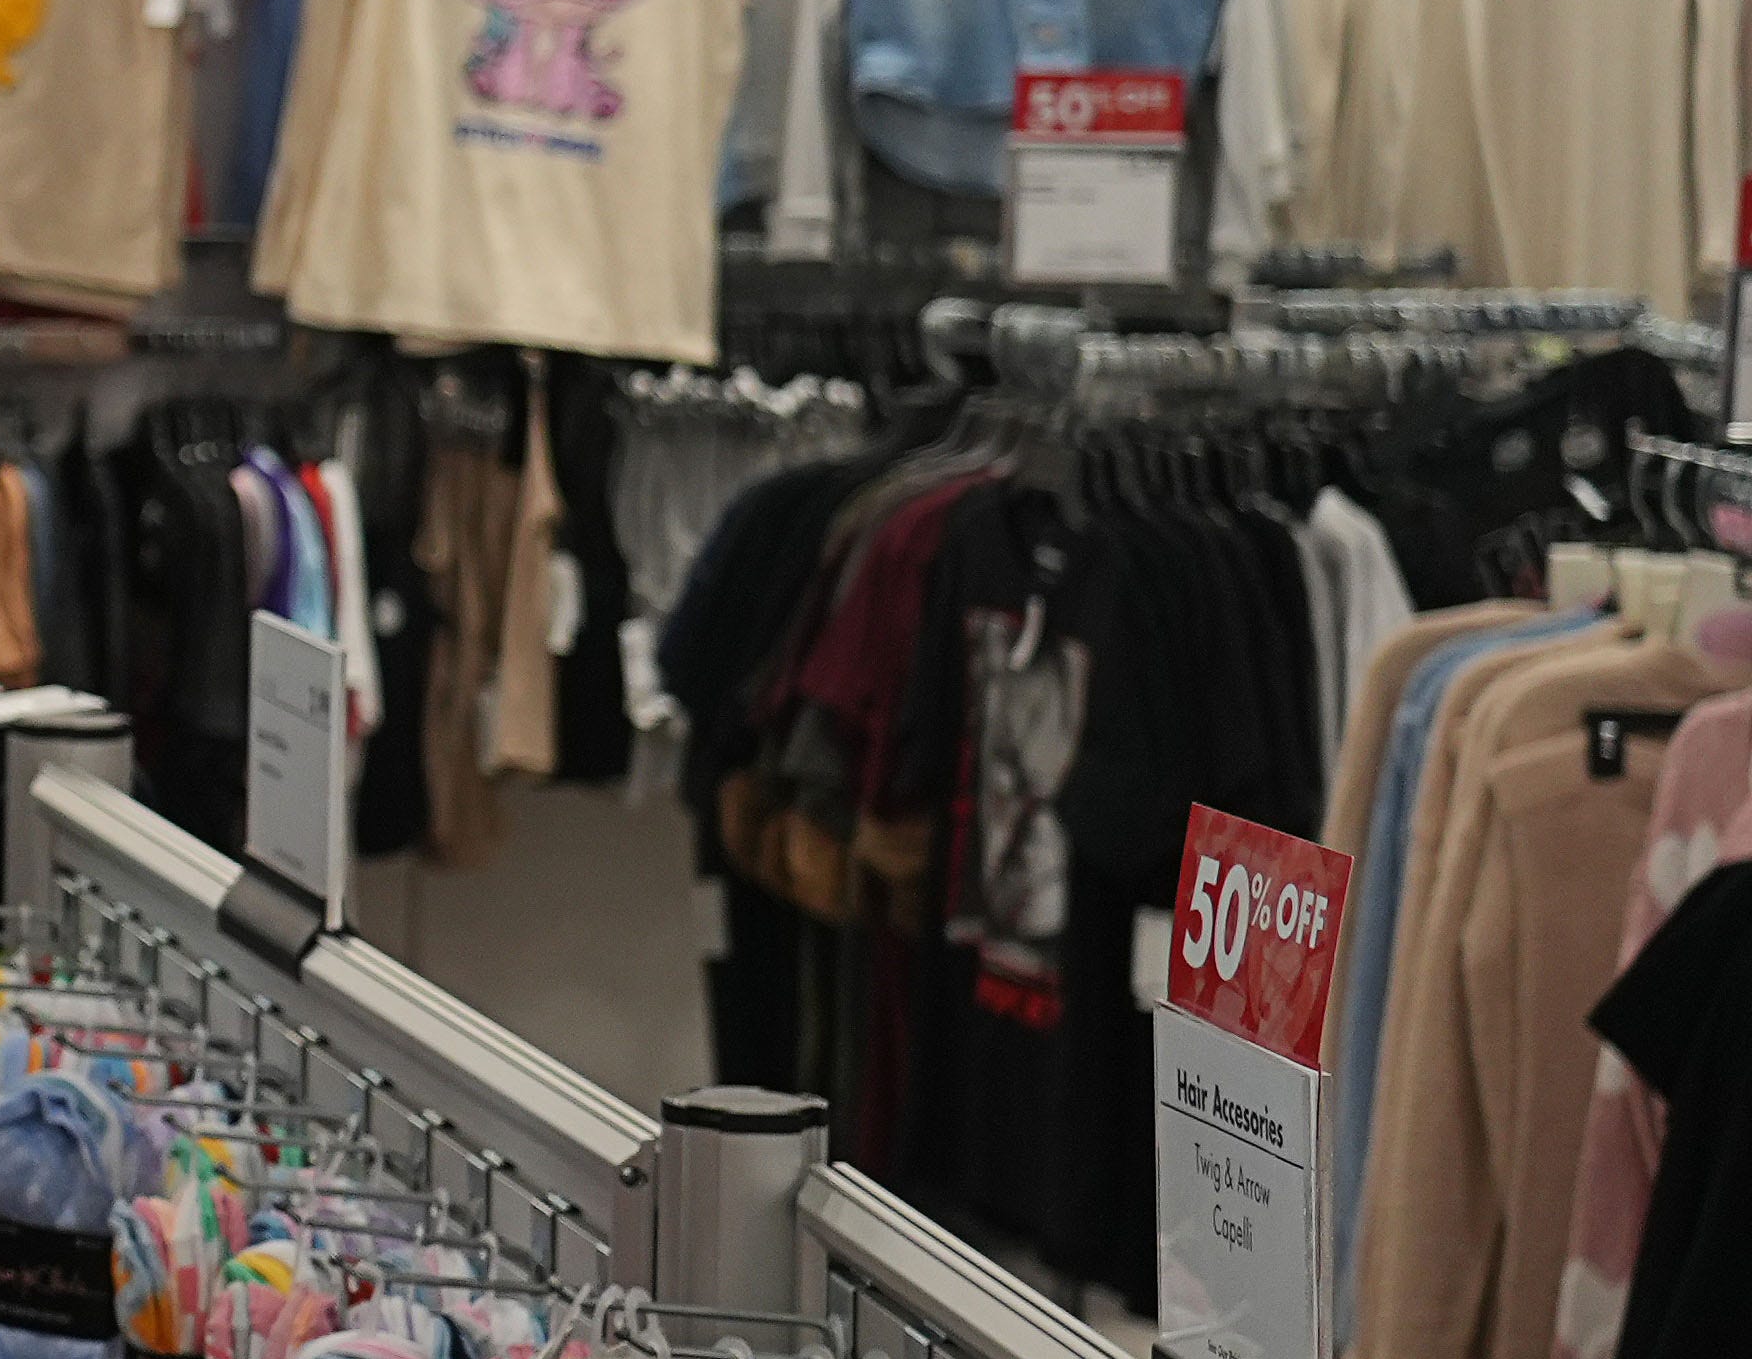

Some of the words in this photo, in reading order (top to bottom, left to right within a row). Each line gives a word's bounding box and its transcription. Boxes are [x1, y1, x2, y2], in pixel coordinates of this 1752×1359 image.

[1181, 854, 1273, 982] 50%
[1276, 886, 1328, 950] OFF
[1176, 1067, 1208, 1112] Hair
[1213, 1084, 1285, 1149] Accesories
[1194, 1142, 1222, 1193] Twig
[1224, 1157, 1234, 1190] &
[1237, 1166, 1271, 1209] Arrow
[1212, 1204, 1254, 1253] Capelli
